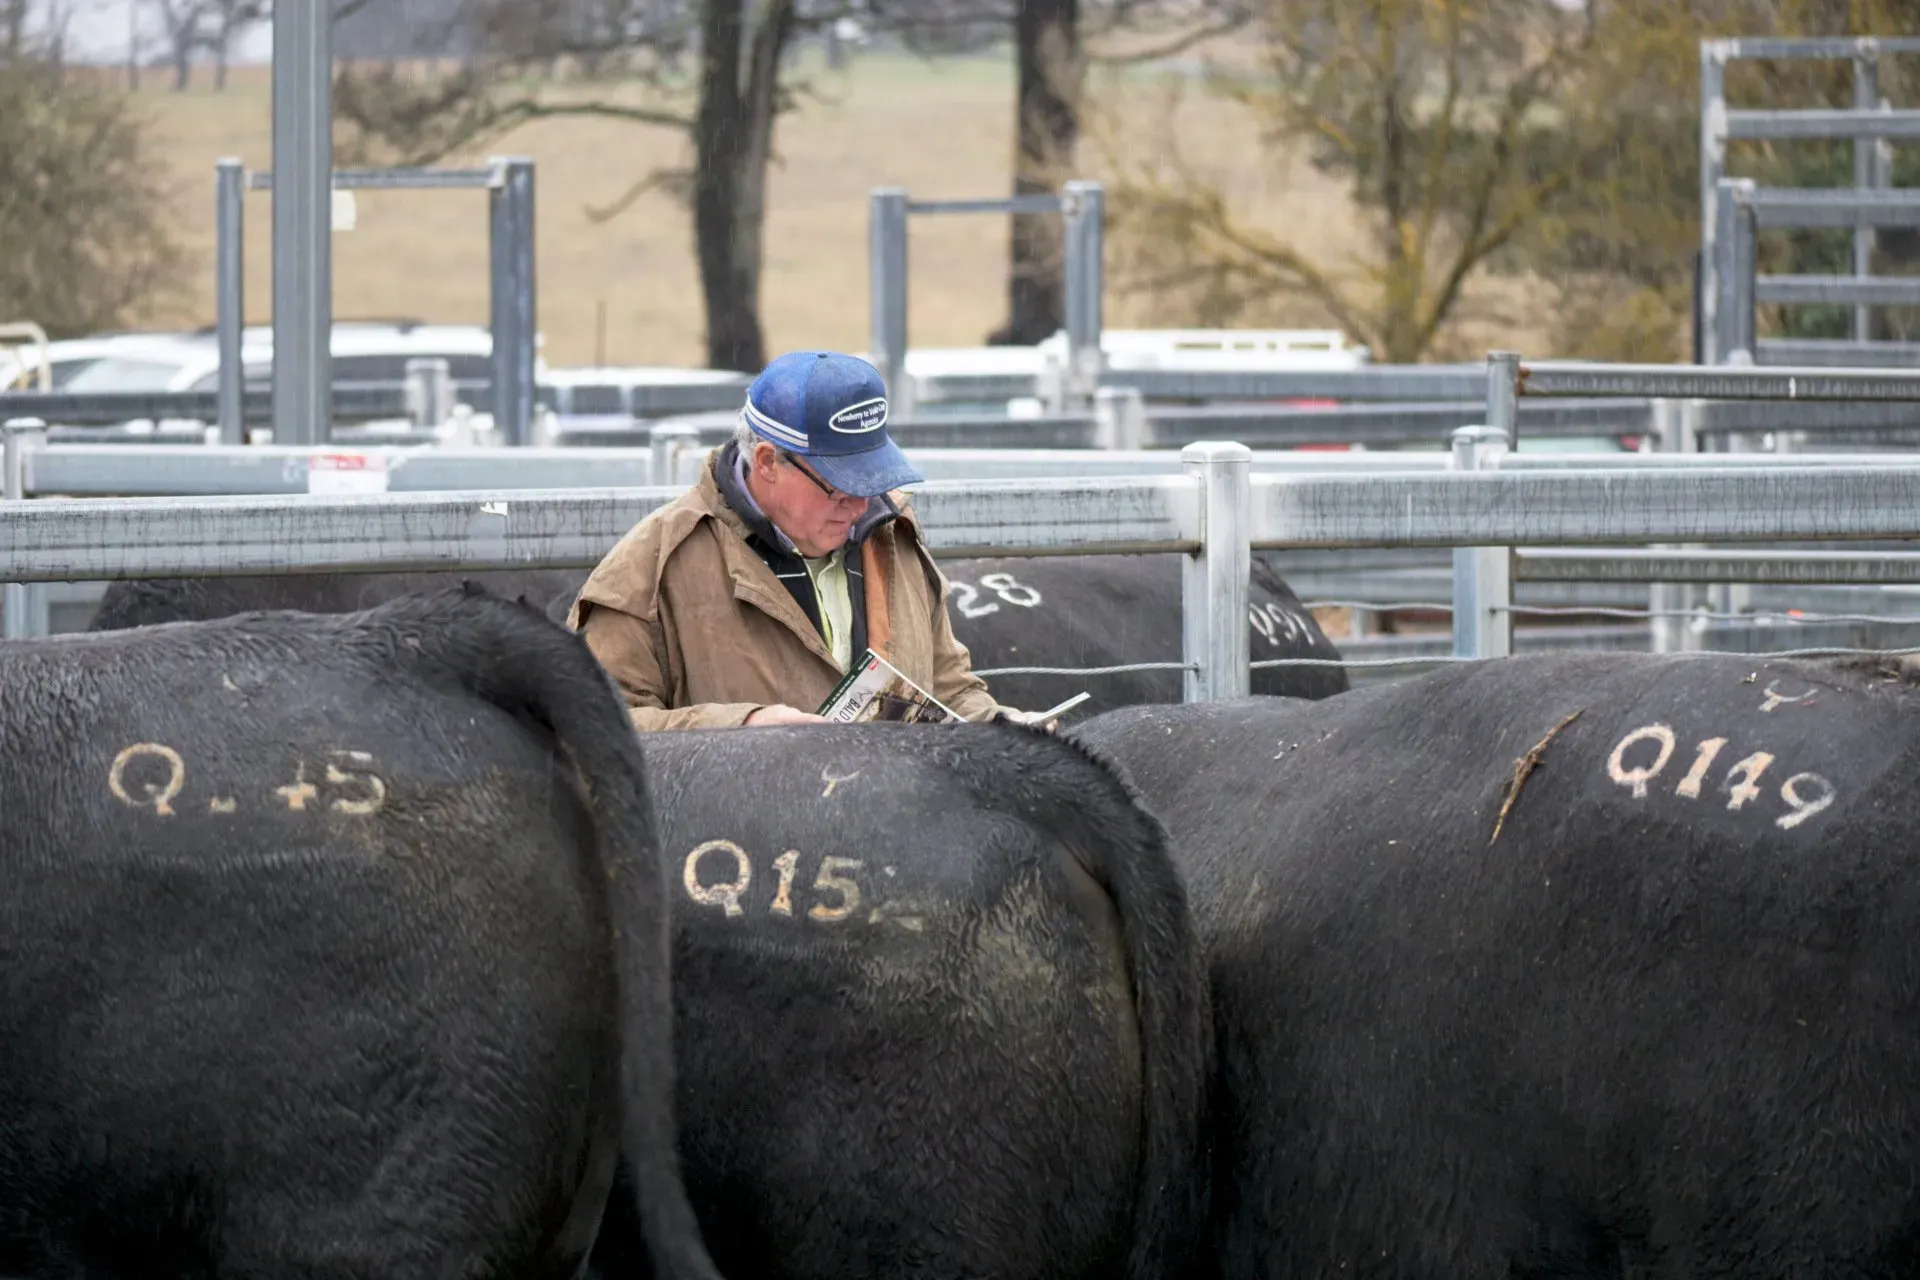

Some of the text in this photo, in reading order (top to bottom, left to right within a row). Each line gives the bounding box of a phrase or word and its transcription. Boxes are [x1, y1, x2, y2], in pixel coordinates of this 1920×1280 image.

[950, 573, 1041, 619] 28
[840, 697, 861, 721] BALD
[1606, 722, 1838, 829] Q149
